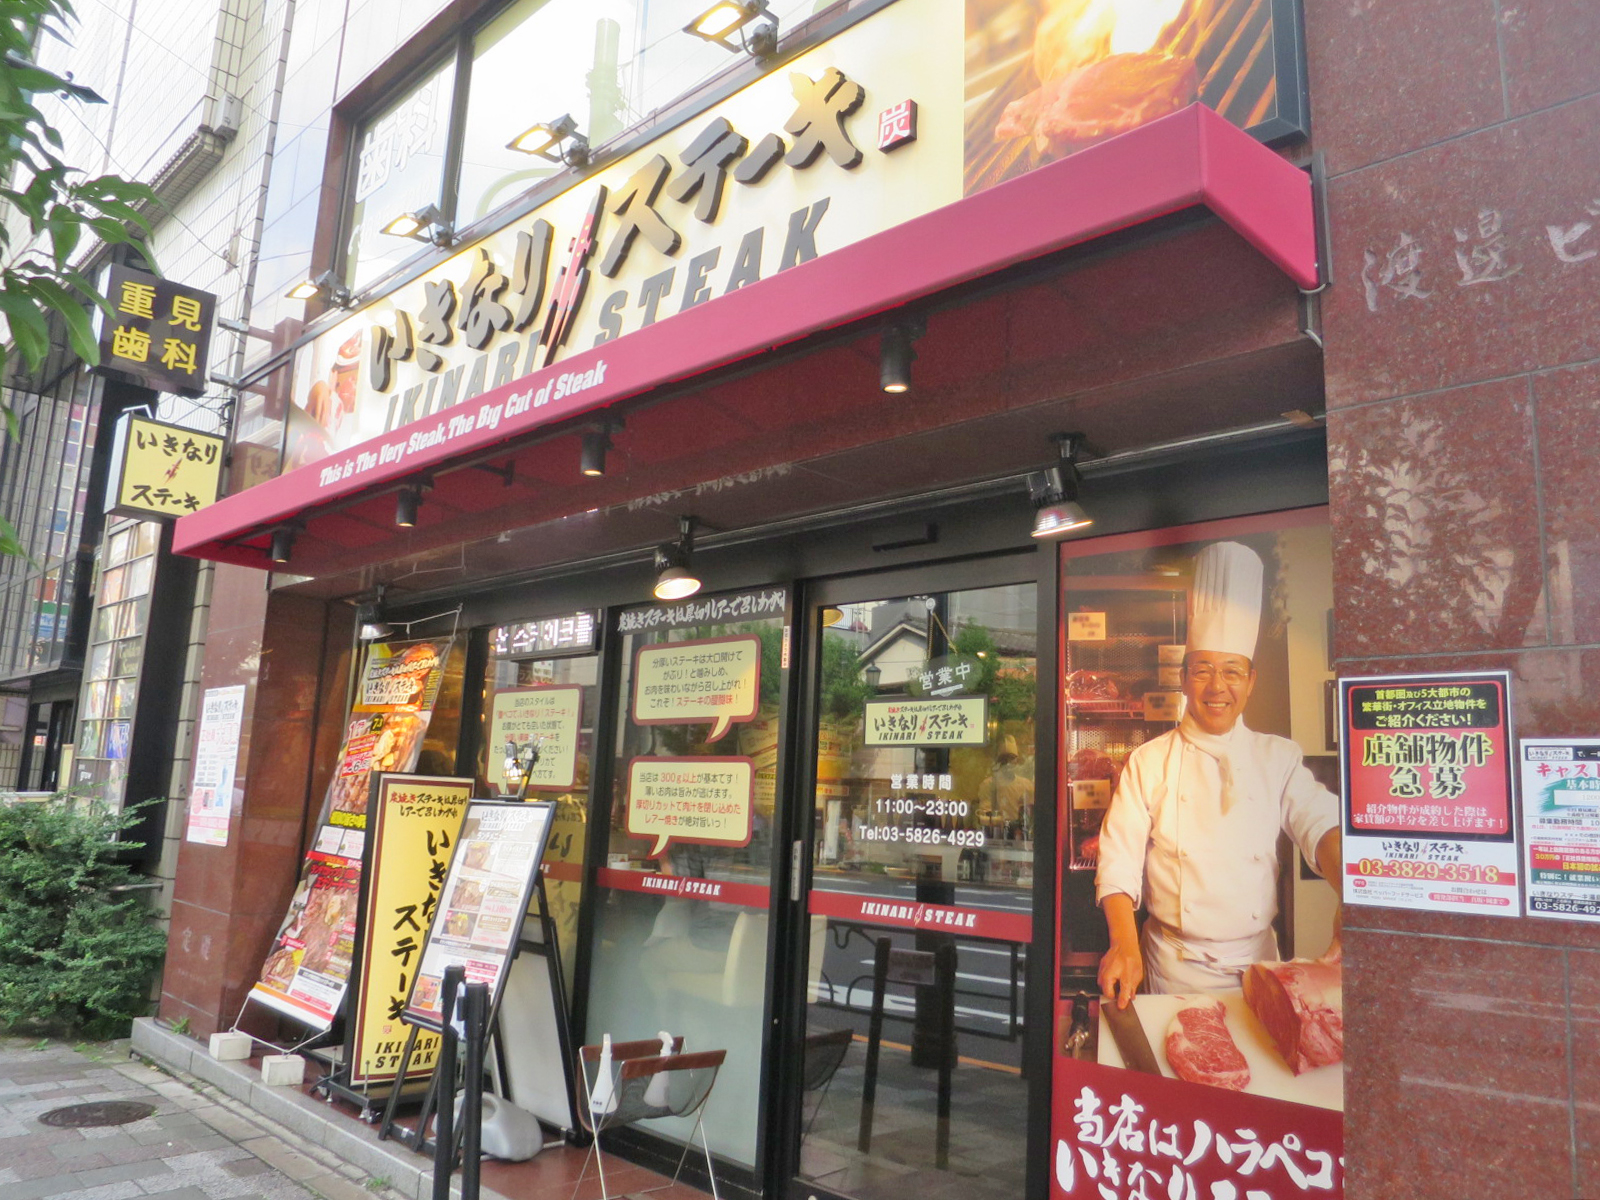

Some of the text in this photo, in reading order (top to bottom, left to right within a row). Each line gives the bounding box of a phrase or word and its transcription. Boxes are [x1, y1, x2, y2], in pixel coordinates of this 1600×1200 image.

[879, 100, 911, 150] 炭
[118, 281, 202, 332] 重見
[382, 197, 831, 435] IKINARI STEAK
[112, 325, 197, 375] 歯科
[319, 465, 342, 487] This
[342, 459, 353, 479] is
[356, 452, 377, 472] The
[378, 435, 406, 465] Very
[448, 407, 475, 439] The
[476, 401, 503, 431] Big
[504, 393, 532, 419] Cut
[533, 379, 554, 407] of
[553, 360, 608, 400] Steak
[136, 430, 218, 465] いきなり
[131, 485, 200, 512] ステーキ
[652, 650, 743, 668] 分厚いステーキは大口開けて
[919, 662, 971, 690] 営業中
[1375, 687, 1471, 700] 首都圏及び5大都市の
[1362, 699, 1487, 712] 繁華街・オフィス立地物件を
[874, 713, 968, 732] いきなりステーキ
[1375, 713, 1472, 728] ご紹介ください！
[879, 730, 964, 741] IKINARI STEAK
[1362, 732, 1494, 767] 店舗物件
[891, 773, 951, 790] 営業時間
[1389, 765, 1466, 799] 急募
[645, 786, 733, 799] 薄いお肉は旨みが逃げます。
[636, 799, 742, 815] 厚切りカットで肉汁を閉じ込めた
[1366, 803, 1487, 817] 紹介物件が成約した際は
[645, 814, 728, 828] レアー焼きが絶対旨いっ！
[1353, 813, 1505, 829] 家賃額の半分を差し上げます！
[859, 825, 985, 847] Tel:03-5826-4929
[1382, 840, 1464, 854] いきなりステーキ
[1428, 854, 1460, 862] STEAK
[1358, 858, 1499, 884] 03-3829-3518
[642, 876, 721, 896] IKINARI STEAK
[861, 901, 976, 928] IKINARI STEAK
[387, 904, 422, 1026] ステーキ
[375, 1036, 438, 1054] IKIARI
[374, 1051, 434, 1069] STAK
[1073, 1086, 1345, 1190] 当店はハラペコ
